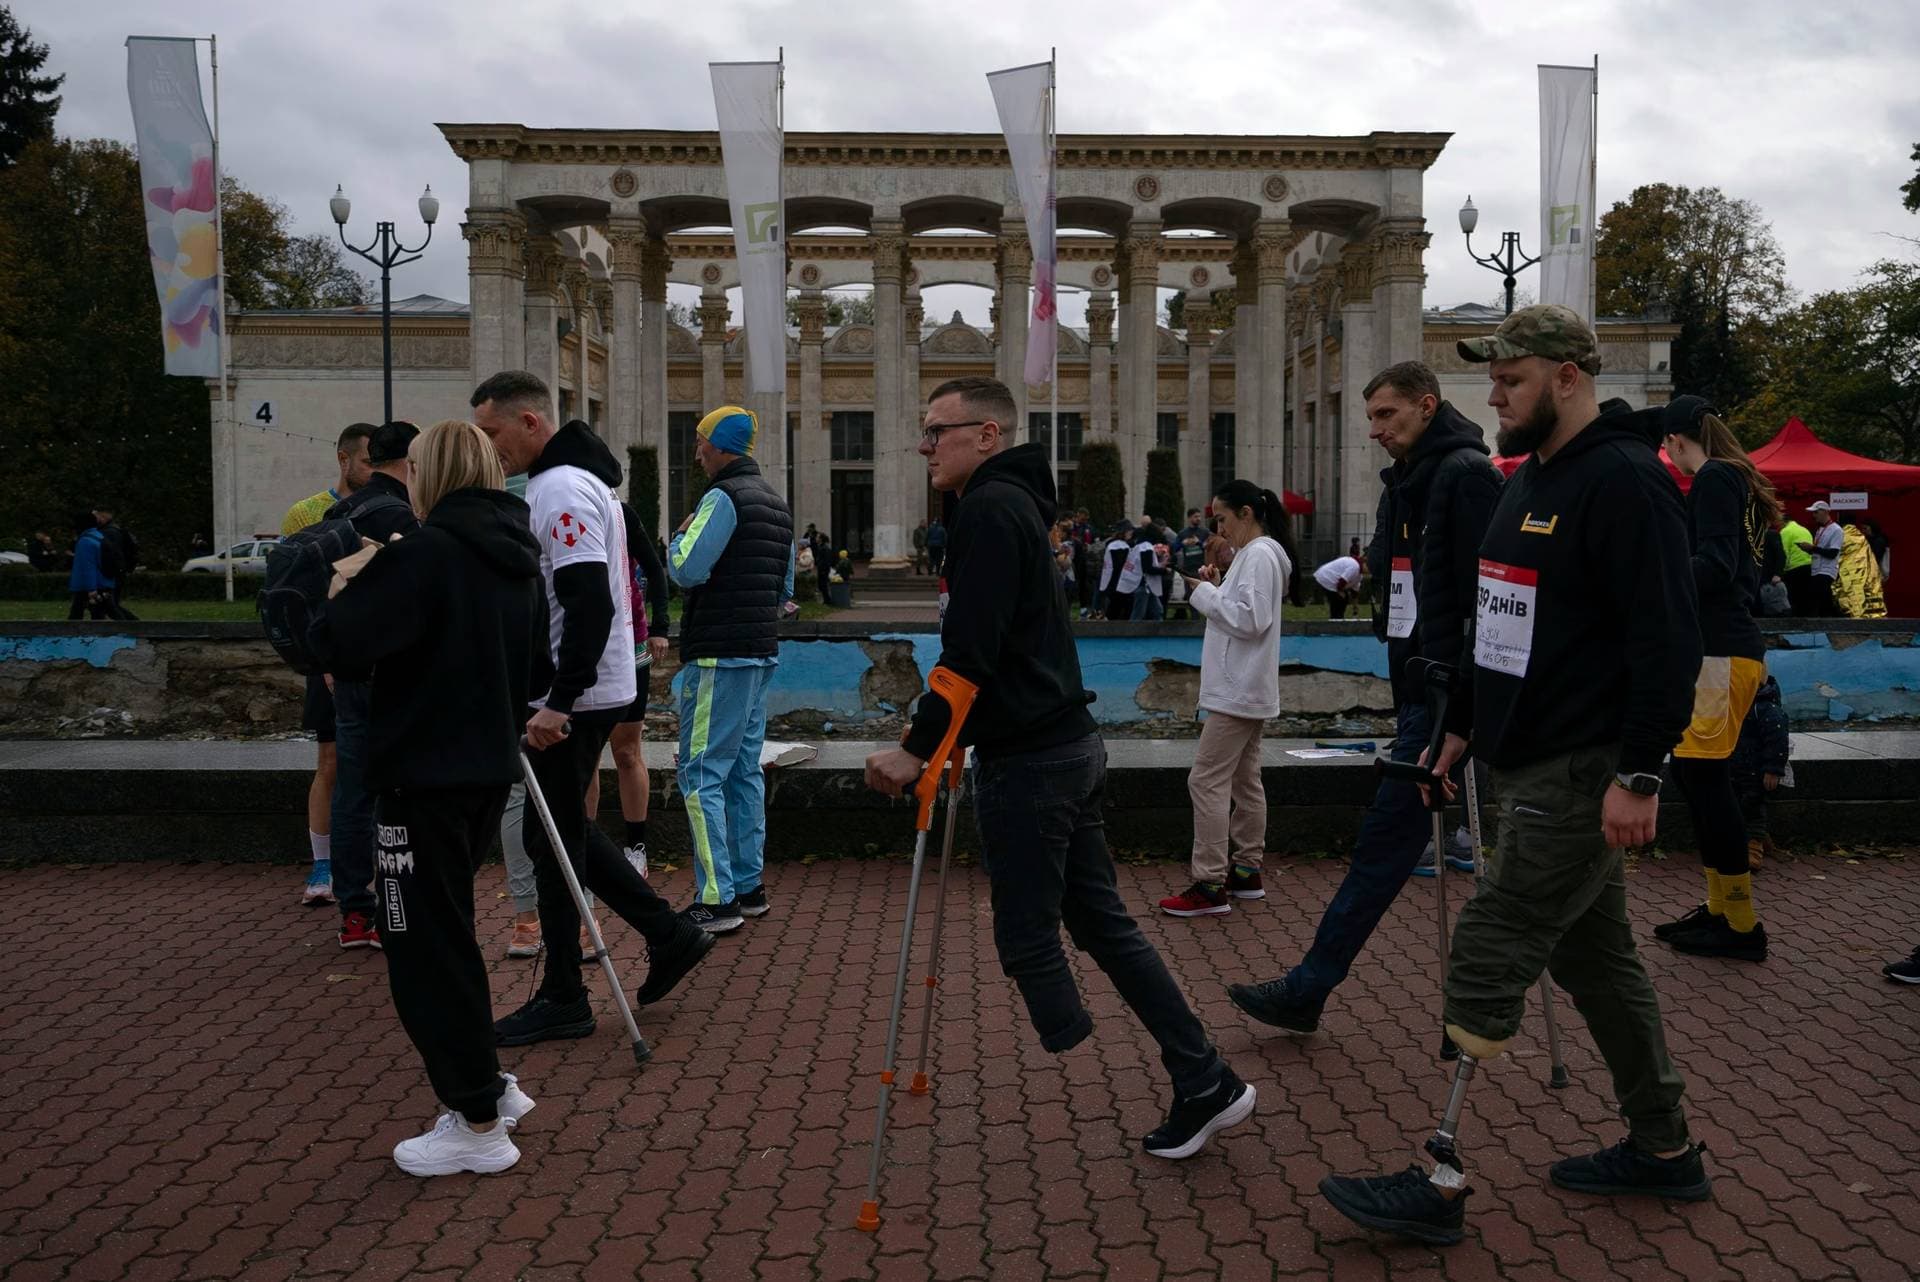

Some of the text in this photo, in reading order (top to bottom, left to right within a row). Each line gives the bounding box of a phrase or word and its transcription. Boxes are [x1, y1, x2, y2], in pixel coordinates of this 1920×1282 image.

[255, 402, 272, 423] 4
[1488, 592, 1528, 617] днів
[388, 882, 404, 927] msgm!
